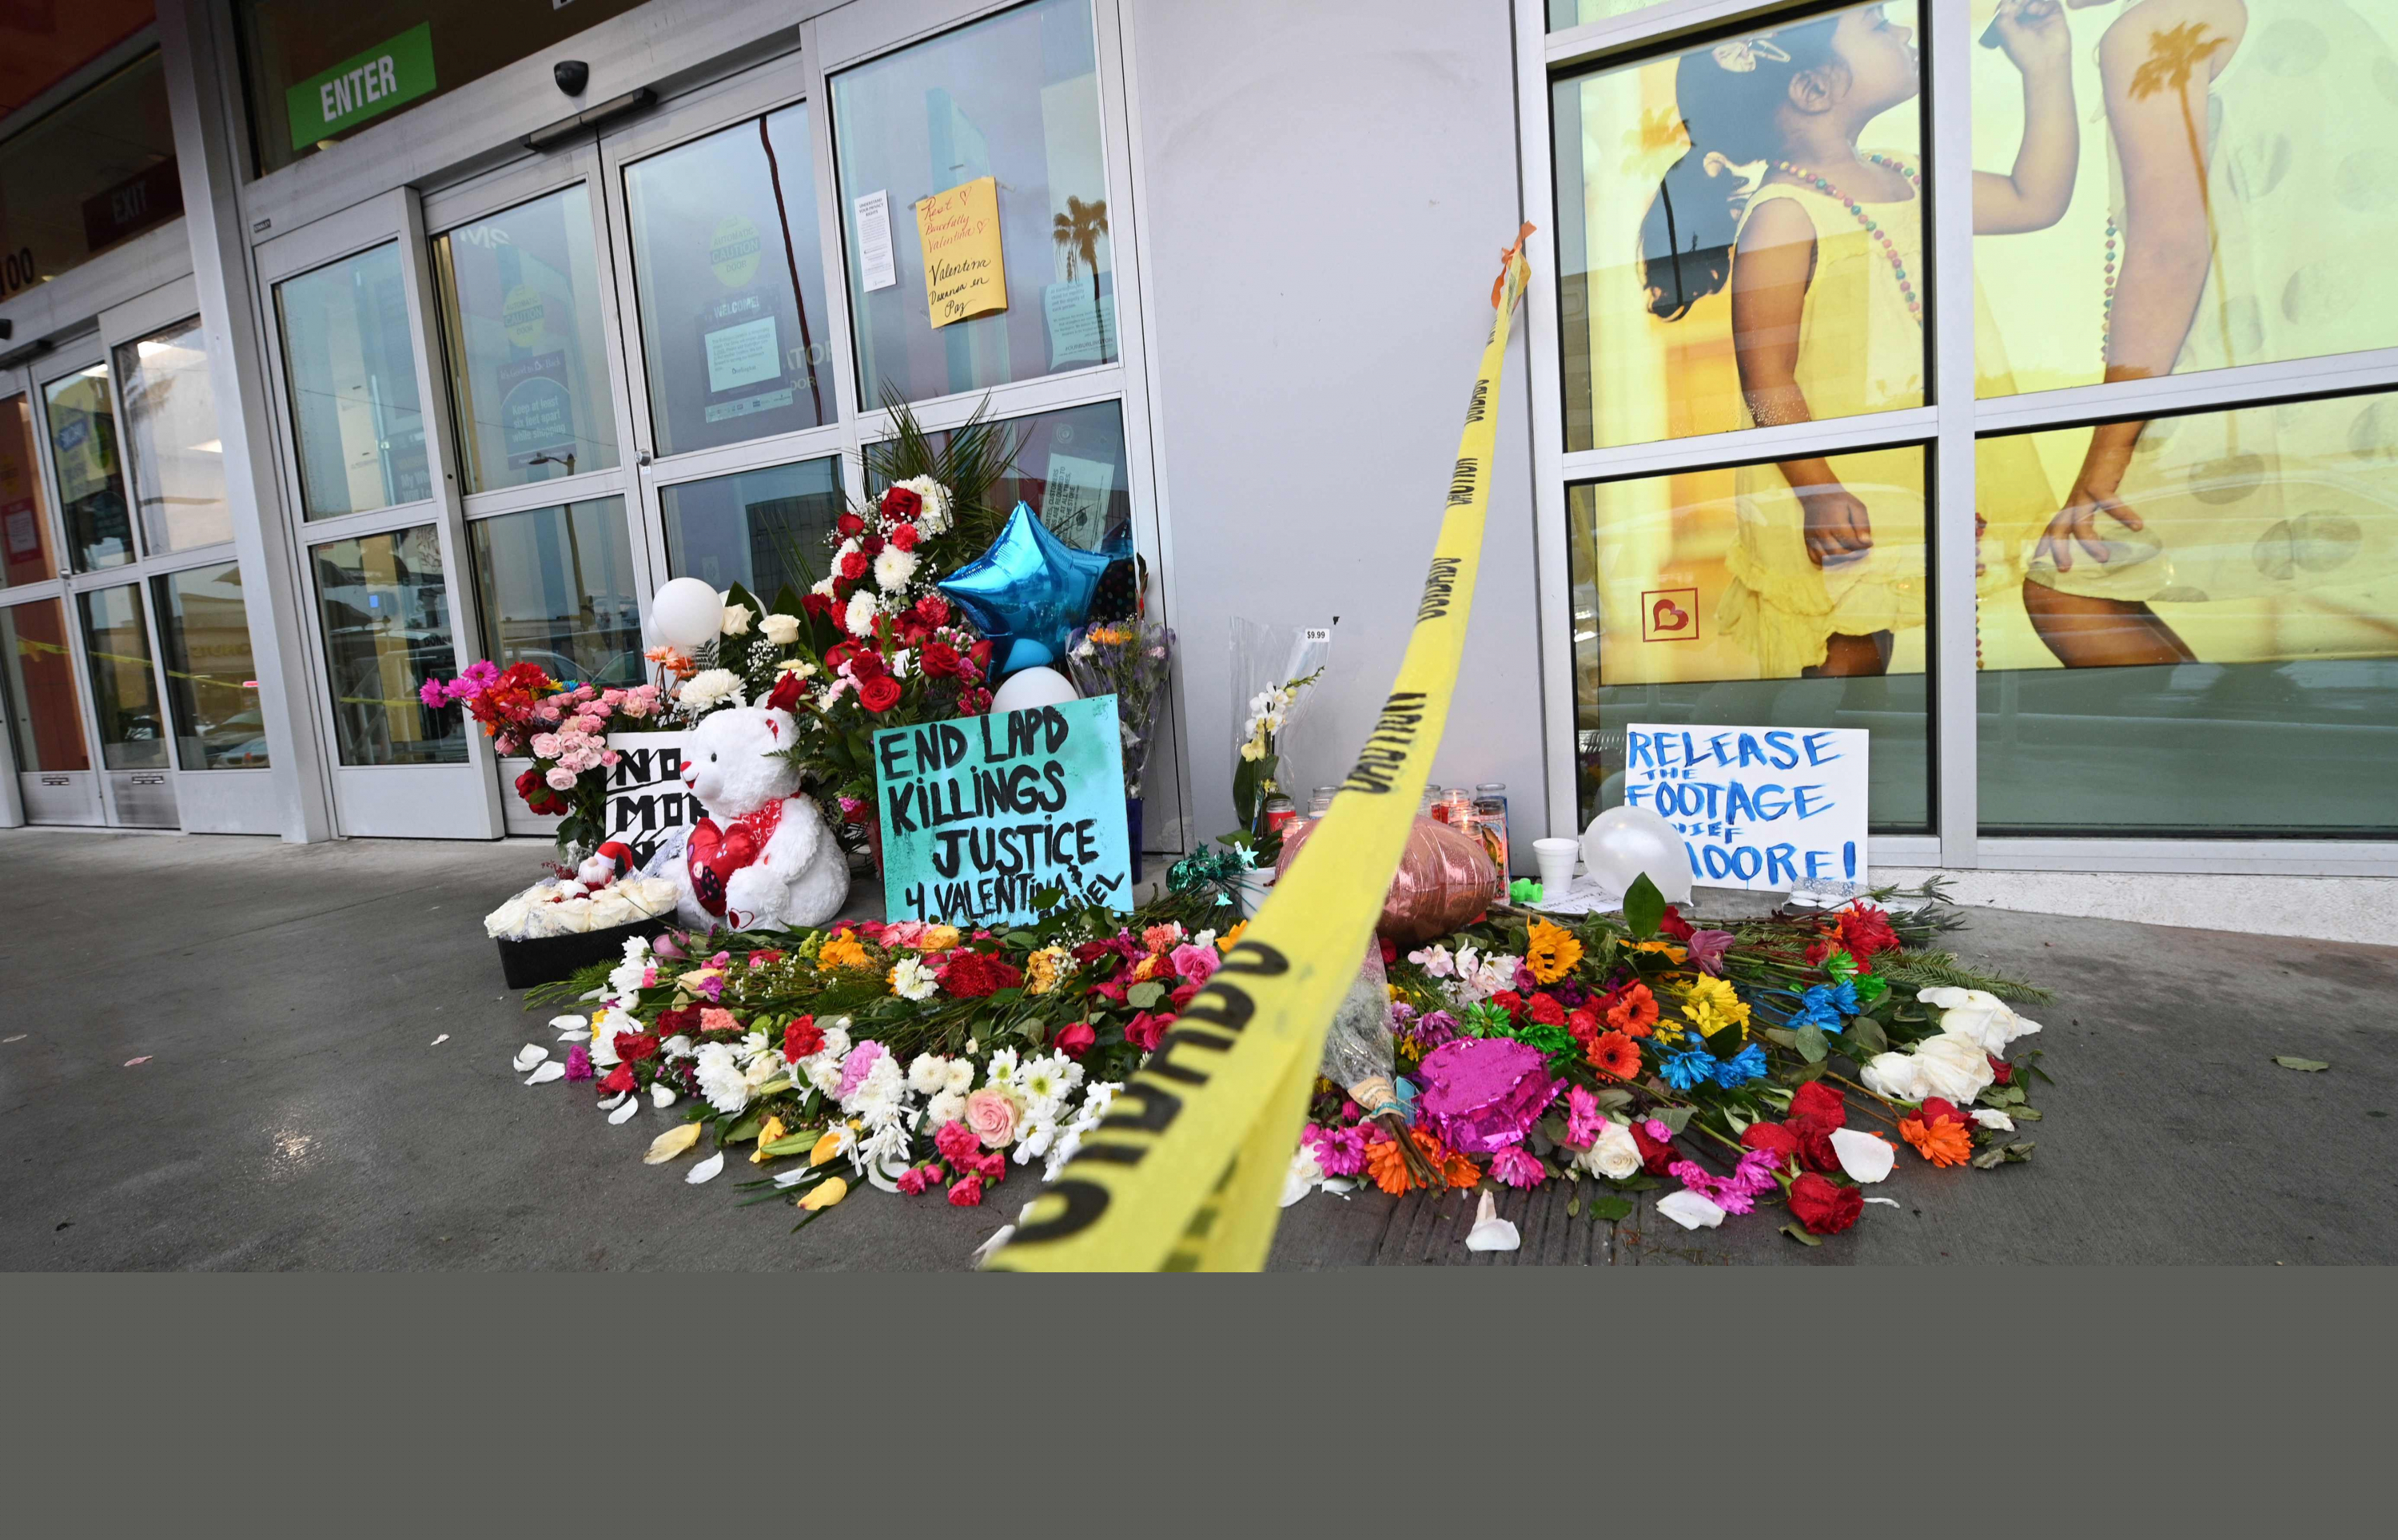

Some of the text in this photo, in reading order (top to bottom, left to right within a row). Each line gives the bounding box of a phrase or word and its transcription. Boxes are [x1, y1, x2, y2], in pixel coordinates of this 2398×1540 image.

[321, 55, 397, 122] ENTER
[110, 180, 146, 225] EXIT
[858, 197, 882, 209] UNDERSTAND
[921, 196, 952, 221] Rest
[712, 241, 758, 263] CAUTION
[928, 228, 975, 253] Valentina
[726, 261, 747, 273] DOOR
[929, 258, 991, 286] Valentina
[970, 277, 990, 289] en
[505, 307, 542, 327] CAUTION
[713, 295, 759, 318] WELCOME!
[945, 299, 976, 317] Paz
[512, 395, 559, 416] Keep at least
[513, 408, 560, 429] six feet apart
[512, 423, 566, 443] while shopping
[1049, 468, 1059, 505] CUSTOMERS
[1055, 476, 1064, 505] REQUIRED
[1307, 631, 1325, 639] $9.99
[879, 705, 1069, 781] END LAPD
[1336, 691, 1428, 794] CAUTION
[1628, 731, 1846, 770] RELEASE
[615, 748, 681, 786] NO
[1639, 766, 1699, 781] THE
[1624, 778, 1836, 825] FOOTAGE
[906, 881, 925, 922] 4
